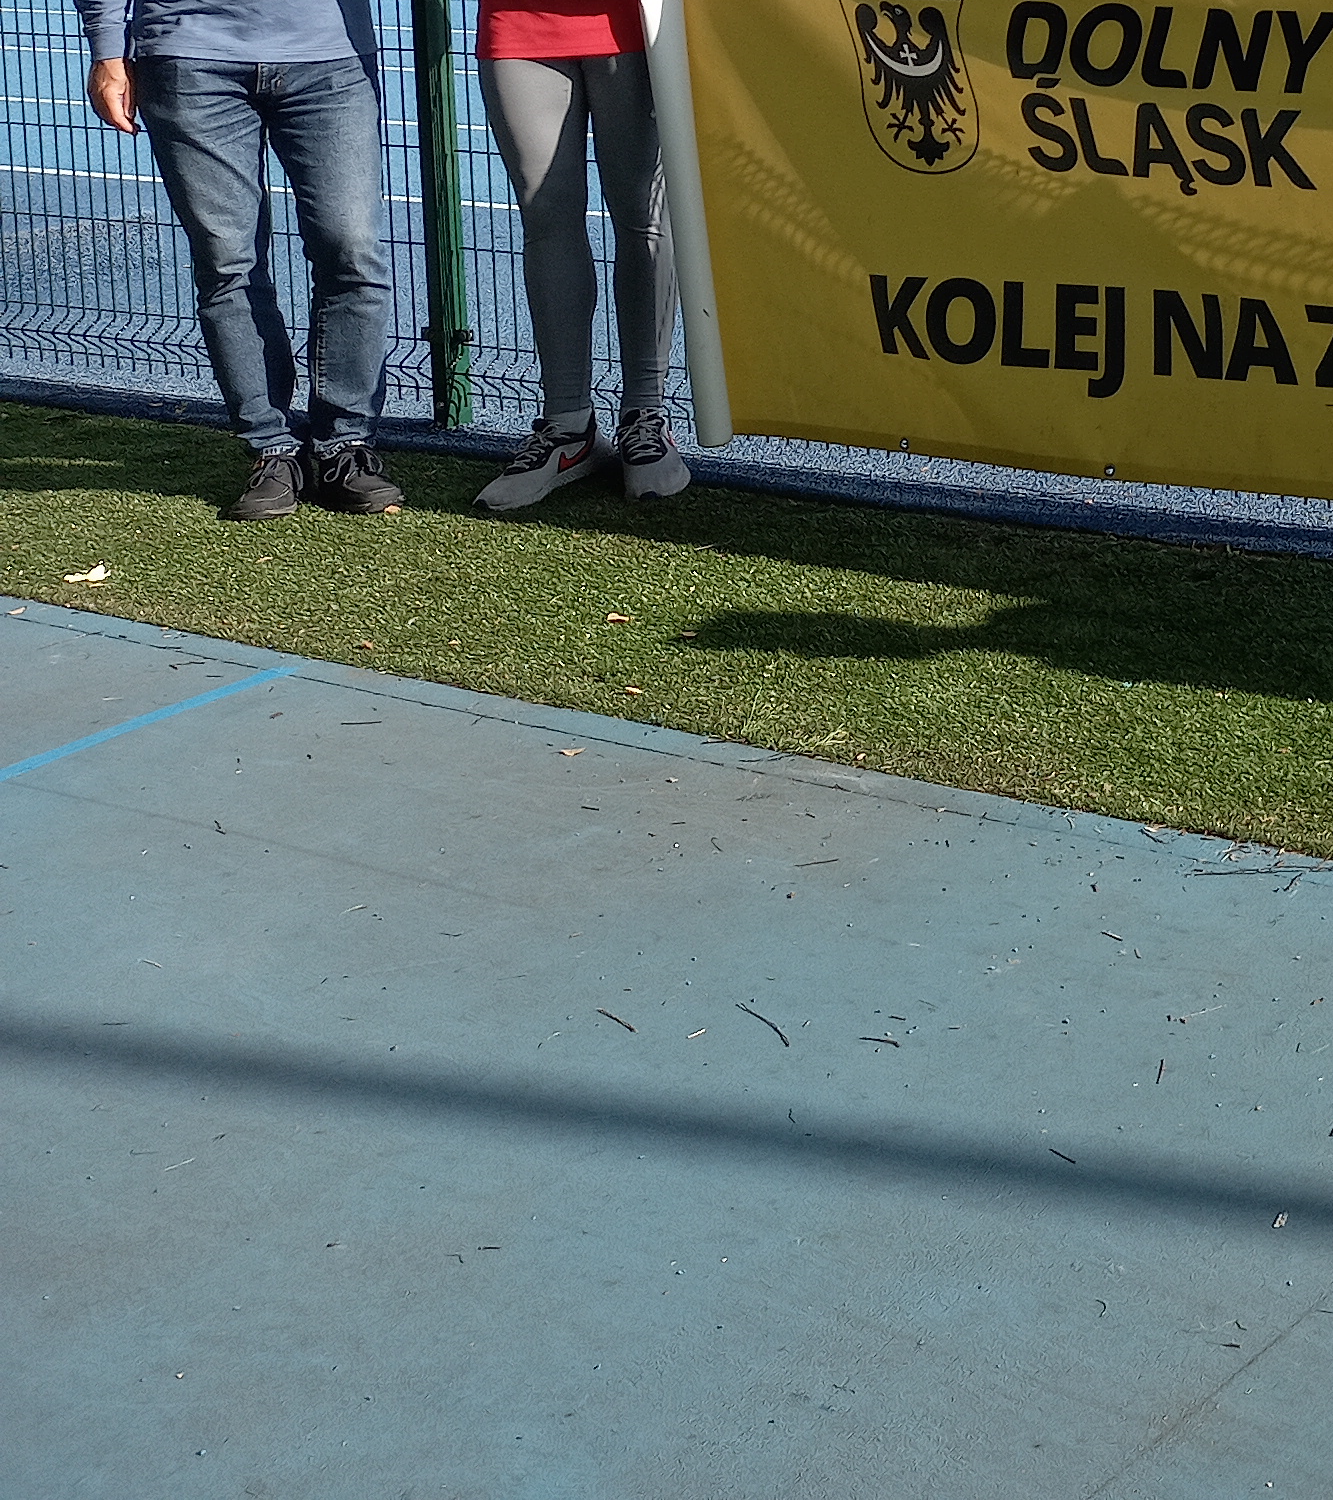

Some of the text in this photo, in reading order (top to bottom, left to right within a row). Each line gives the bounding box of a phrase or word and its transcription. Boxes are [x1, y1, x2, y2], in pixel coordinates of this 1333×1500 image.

[1021, 76, 1318, 196] ŚLĄSK
[868, 273, 1127, 399] KOLEJ
[1153, 288, 1299, 387] NA
